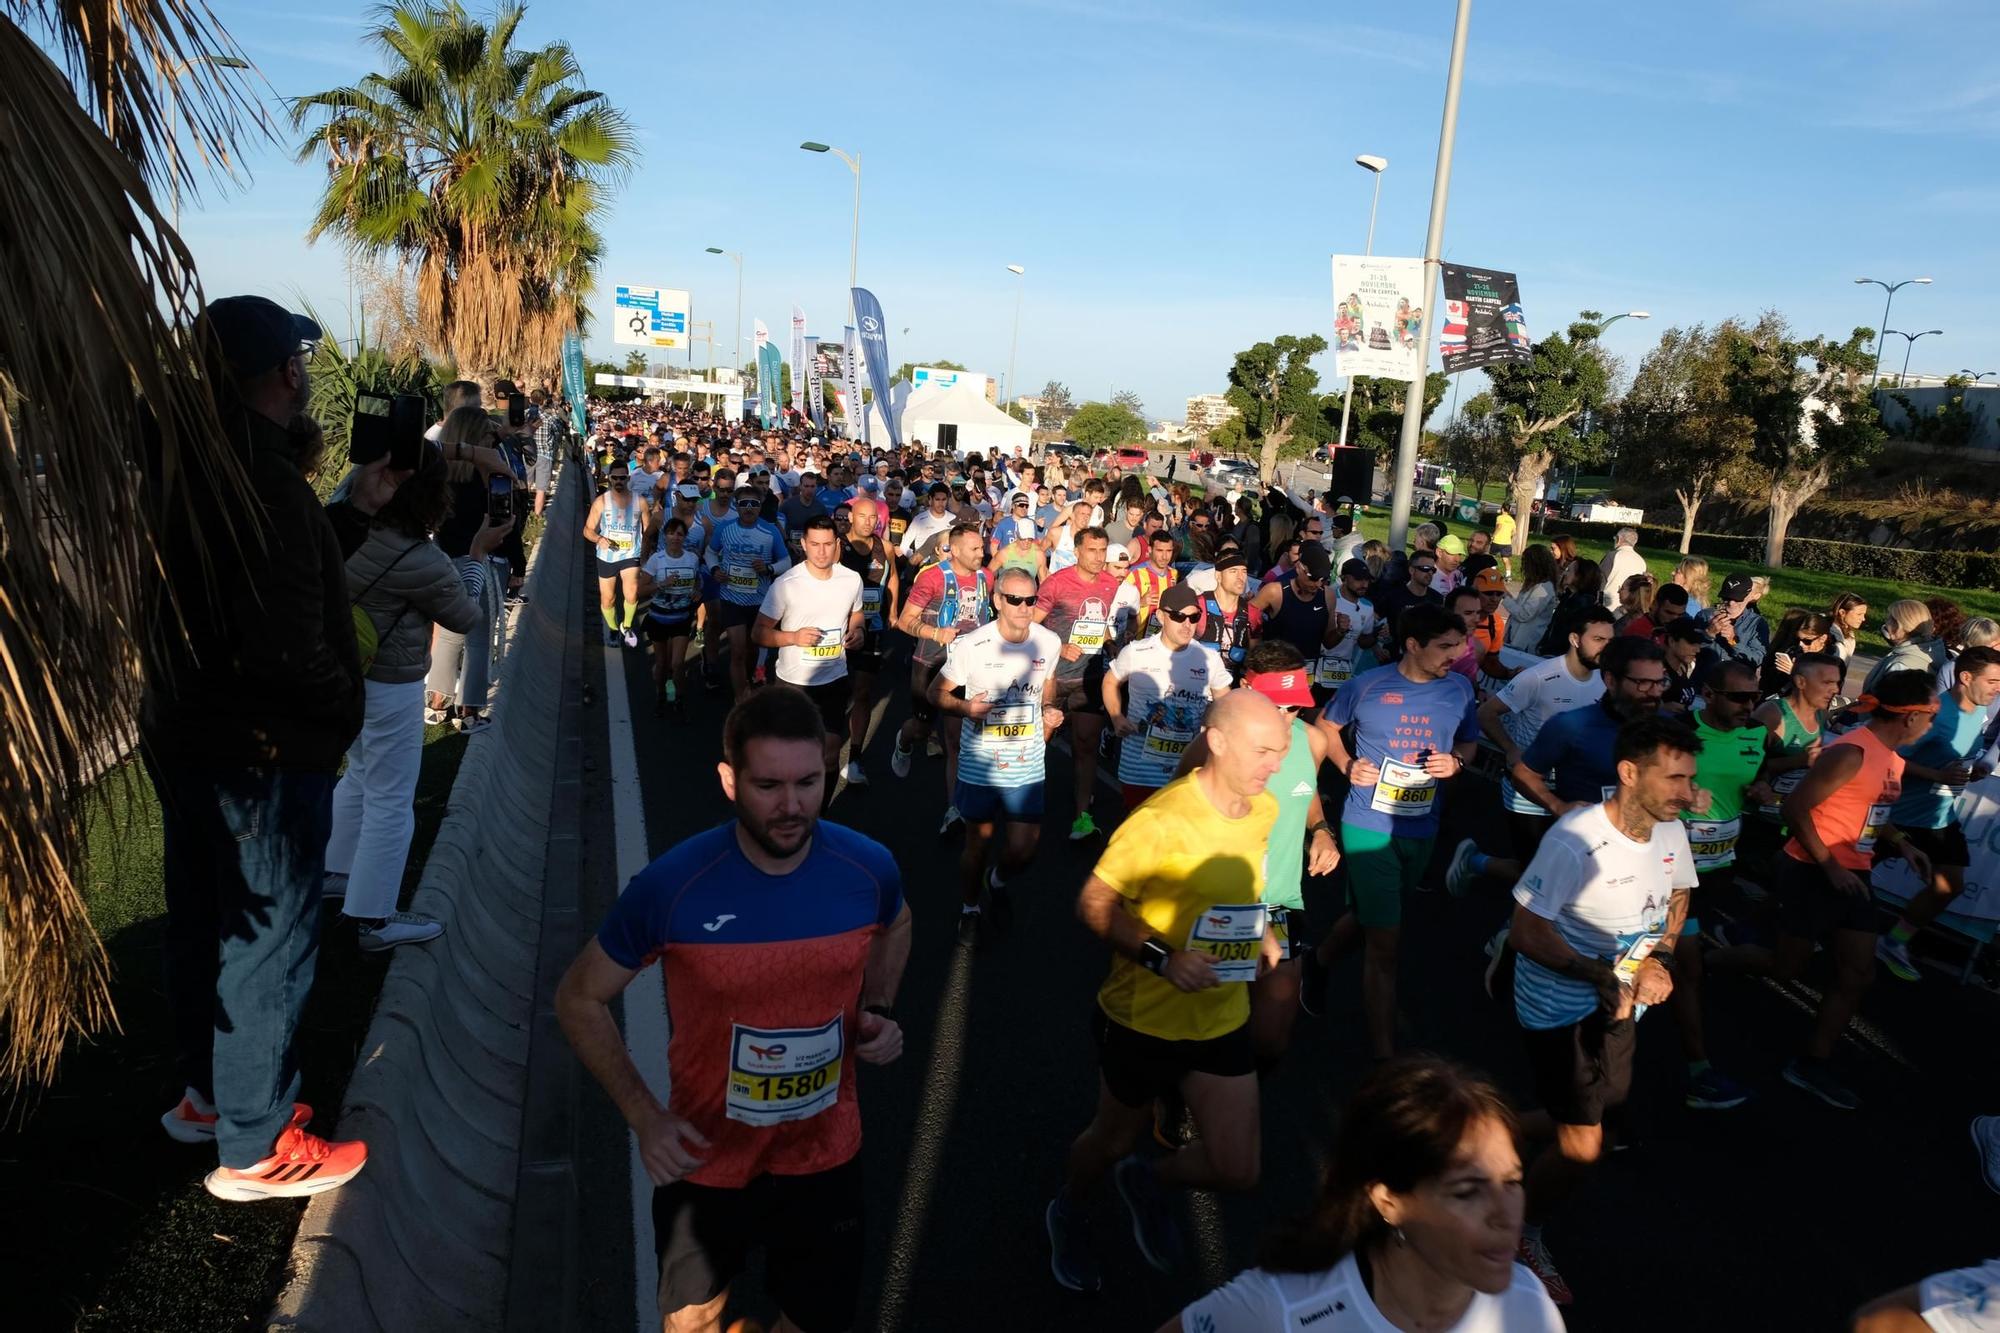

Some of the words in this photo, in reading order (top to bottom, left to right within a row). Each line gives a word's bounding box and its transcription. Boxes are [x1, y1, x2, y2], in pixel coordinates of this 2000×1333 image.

[733, 578, 753, 586] 2009
[1077, 636, 1099, 645] 2060
[812, 646, 836, 656] 1077
[1400, 714, 1430, 724] RUN
[996, 725, 1027, 736] 1087
[1395, 727, 1433, 738] YOUR
[1158, 741, 1187, 754] 1187
[1389, 739, 1437, 750] WORLD
[1393, 788, 1428, 802] 1860
[1208, 943, 1251, 961] 1030
[758, 1069, 827, 1101] 1580
